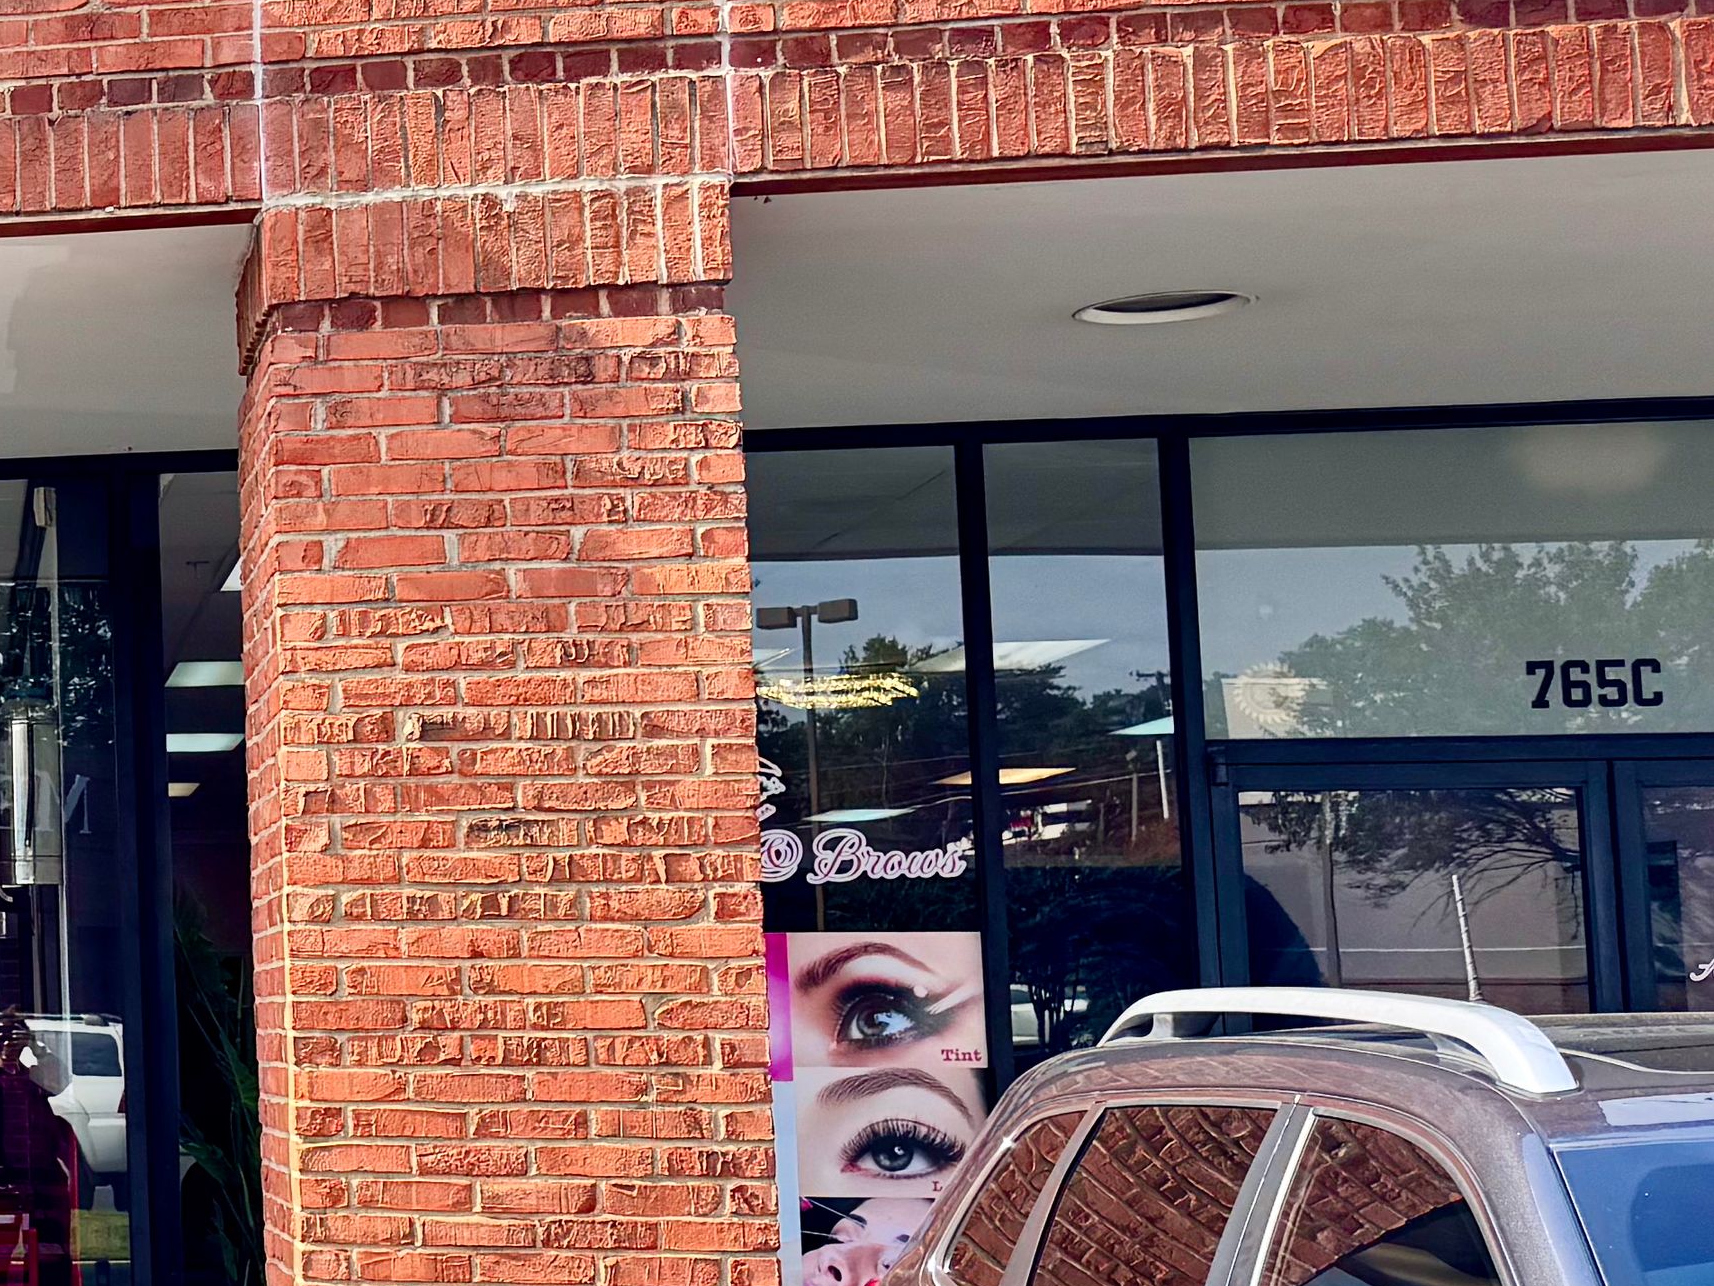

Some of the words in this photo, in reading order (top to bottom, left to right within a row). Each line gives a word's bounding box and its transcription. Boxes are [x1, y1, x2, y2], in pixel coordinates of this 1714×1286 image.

[1525, 658, 1664, 709] 765C
[806, 827, 967, 885] Brows
[941, 1049, 982, 1062] Tint
